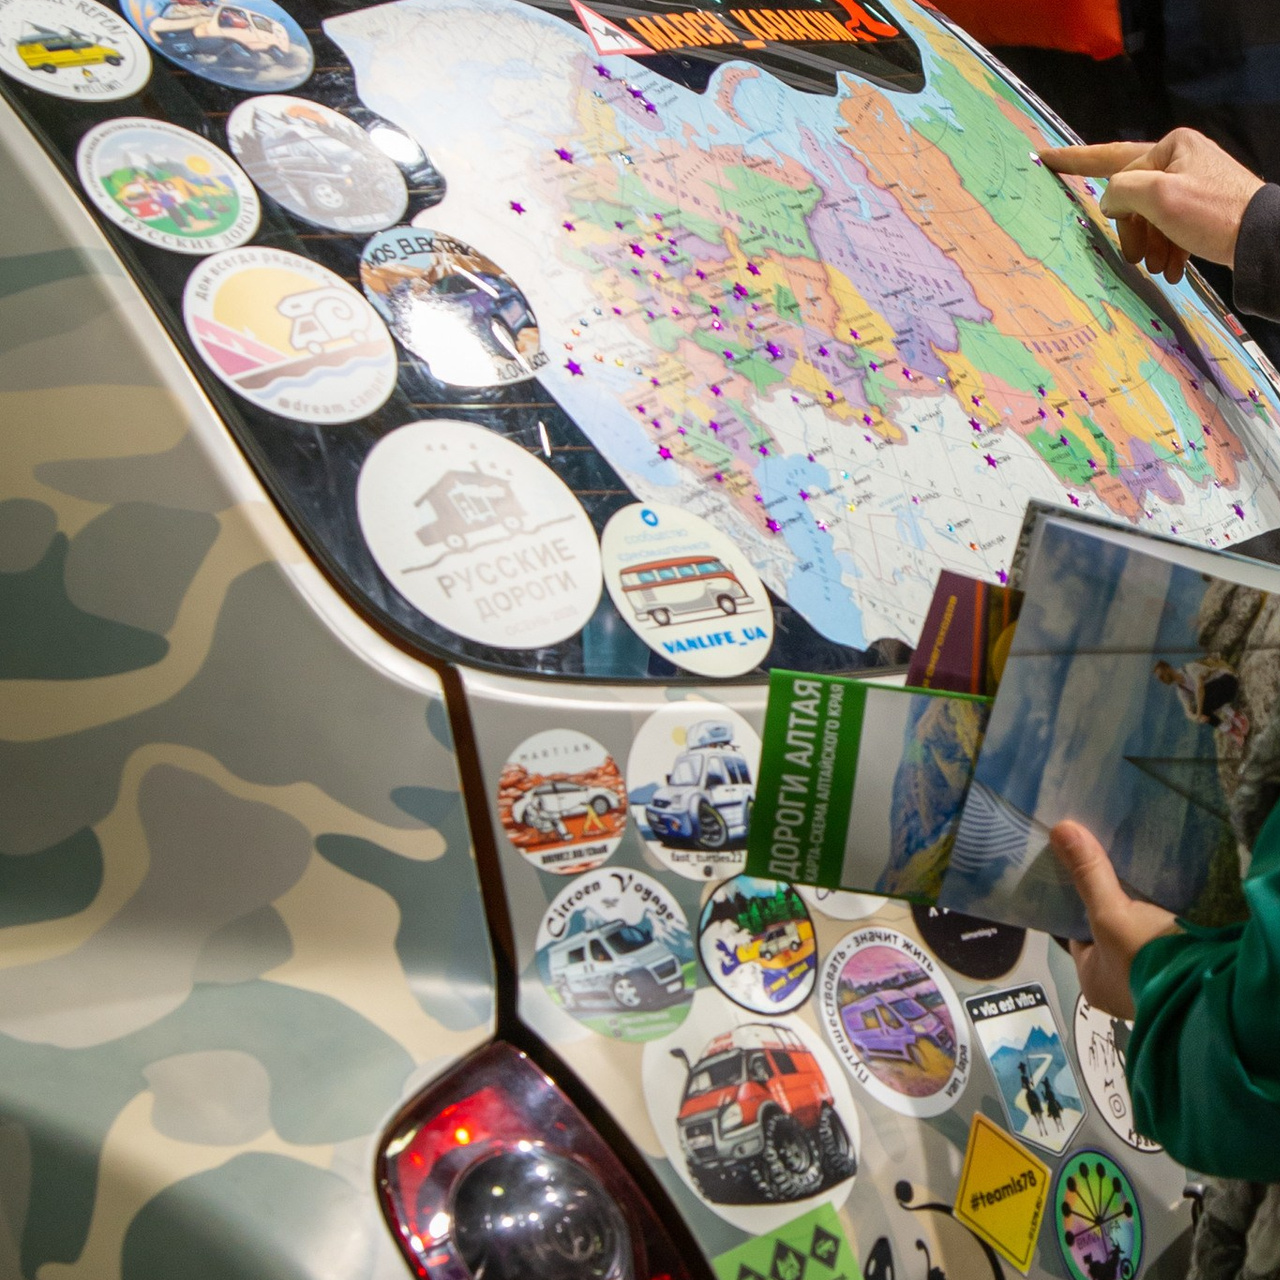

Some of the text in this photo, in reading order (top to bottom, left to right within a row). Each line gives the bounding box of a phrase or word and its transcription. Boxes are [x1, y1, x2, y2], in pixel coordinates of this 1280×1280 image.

[76, 0, 128, 35] REPEAT
[626, 9, 858, 51] MARCH_KARAKUM
[122, 216, 219, 250] РУССКИЕ
[436, 537, 578, 599] РУССКИЕ
[475, 570, 579, 624] ДОРОГИ
[662, 627, 768, 656] VANLIFE_UA
[827, 684, 844, 717] КРАЯ
[519, 742, 592, 762] MARTIAN
[816, 719, 841, 801] АЛТАЙСКОГО
[769, 679, 823, 881] ДОРОГИ АЛТАЯ
[547, 873, 675, 938] Citroen Voyage
[981, 991, 1036, 1017] via est vita
